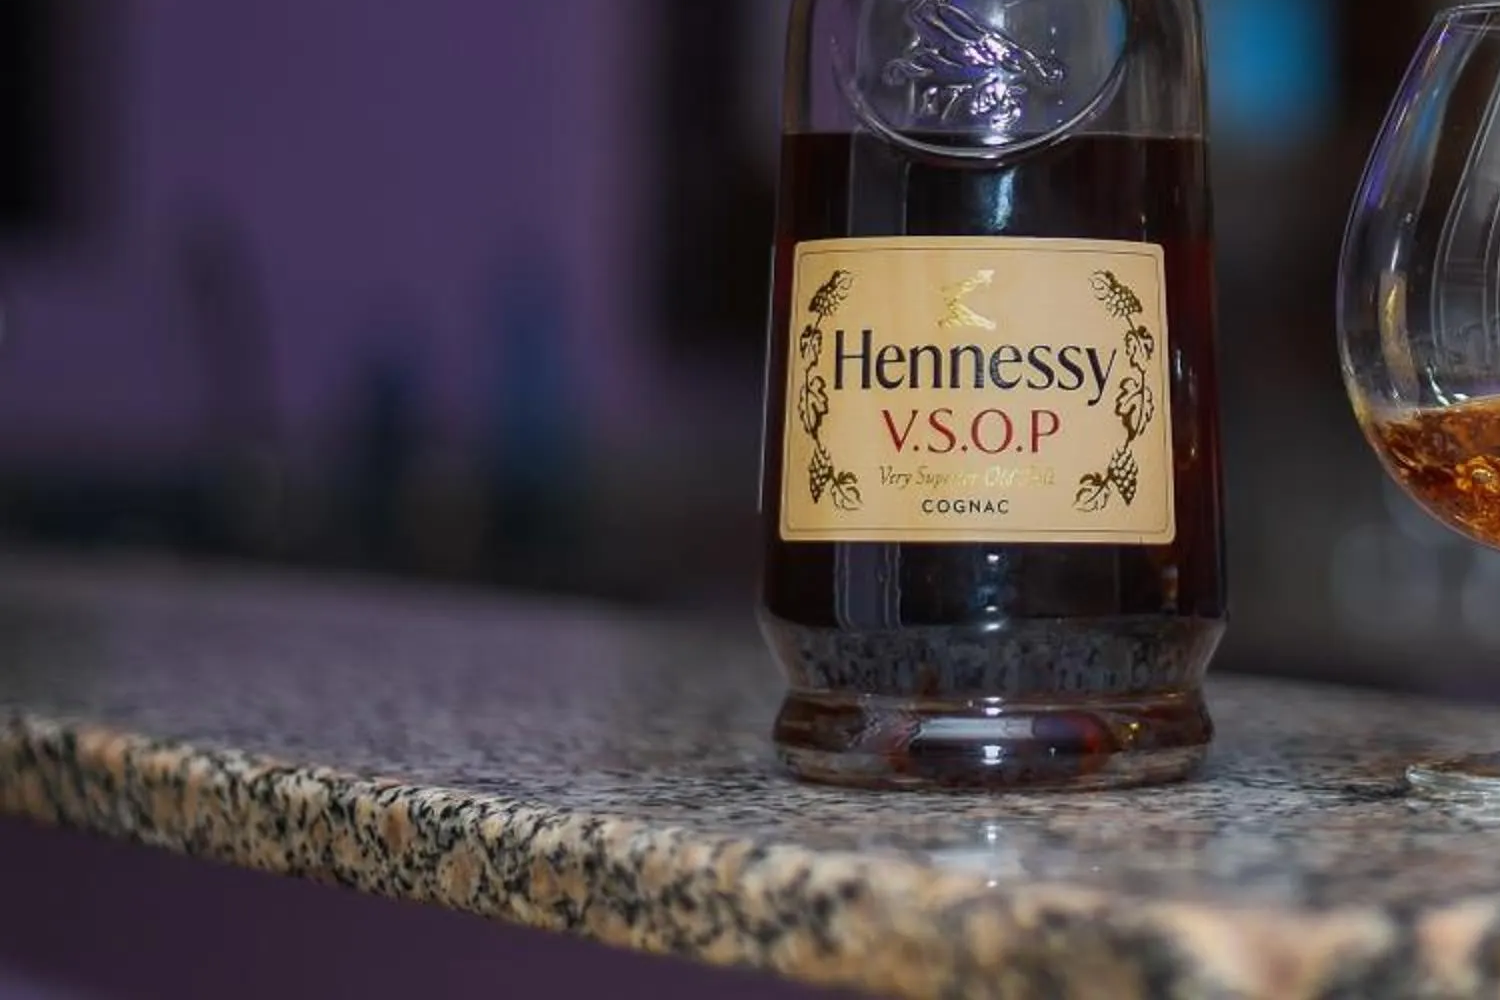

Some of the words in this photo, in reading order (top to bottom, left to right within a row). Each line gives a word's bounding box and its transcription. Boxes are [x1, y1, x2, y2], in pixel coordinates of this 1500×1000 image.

[834, 329, 1117, 406] Hennessy
[880, 409, 1060, 453] V.S.O.P
[879, 465, 913, 489] Very
[922, 499, 1009, 514] COGNAC
